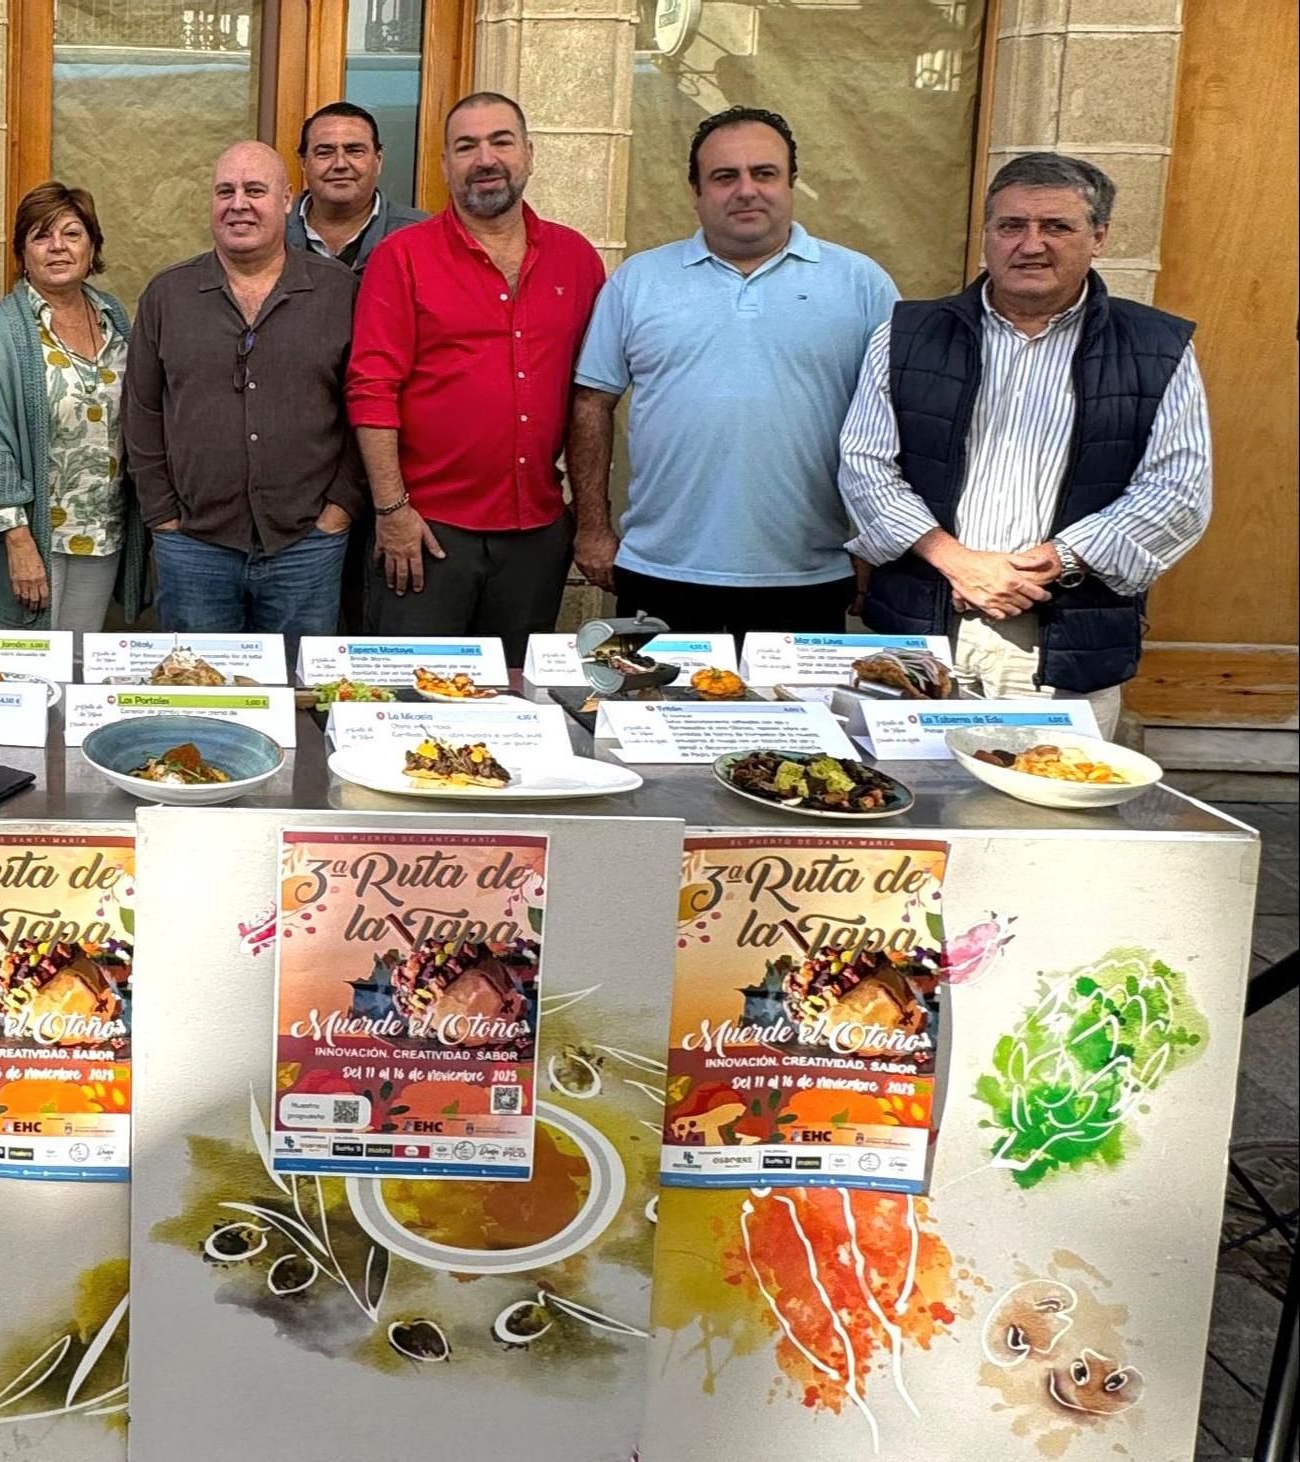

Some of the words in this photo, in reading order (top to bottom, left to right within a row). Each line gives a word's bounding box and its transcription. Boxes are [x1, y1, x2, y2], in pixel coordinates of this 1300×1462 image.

[68, 852, 121, 889] de
[294, 858, 349, 903] 3ª
[350, 850, 467, 907] Ruta
[476, 851, 530, 889] de
[690, 863, 743, 912] 3ª
[745, 854, 863, 913] Ruta
[874, 855, 929, 893] de
[344, 903, 390, 941] la
[402, 908, 522, 956] Tapa
[736, 909, 786, 948] la
[797, 913, 922, 963] Tapa
[3, 1010, 27, 1036] el
[33, 1011, 118, 1045] Otoño
[291, 1009, 403, 1047] Muerde
[408, 1011, 431, 1037] el
[438, 1012, 520, 1045] Otoño
[682, 1017, 793, 1058] Muerde
[798, 1018, 824, 1045] el
[829, 1021, 919, 1054] Otoño
[72, 1049, 114, 1061] SABOR
[314, 1046, 390, 1059] INNOVACIÓN.
[476, 1050, 518, 1062] SABOR
[705, 1055, 780, 1068] INNOVACIÓN.
[782, 1057, 868, 1071] CREATIVIDAD.
[870, 1062, 917, 1074] SABOR
[342, 1066, 362, 1080] Del
[365, 1067, 375, 1078] 11
[379, 1067, 390, 1080] al
[394, 1068, 404, 1080] 16
[408, 1068, 424, 1080] de
[427, 1069, 485, 1082] noviembre
[491, 1070, 518, 1082] 2025
